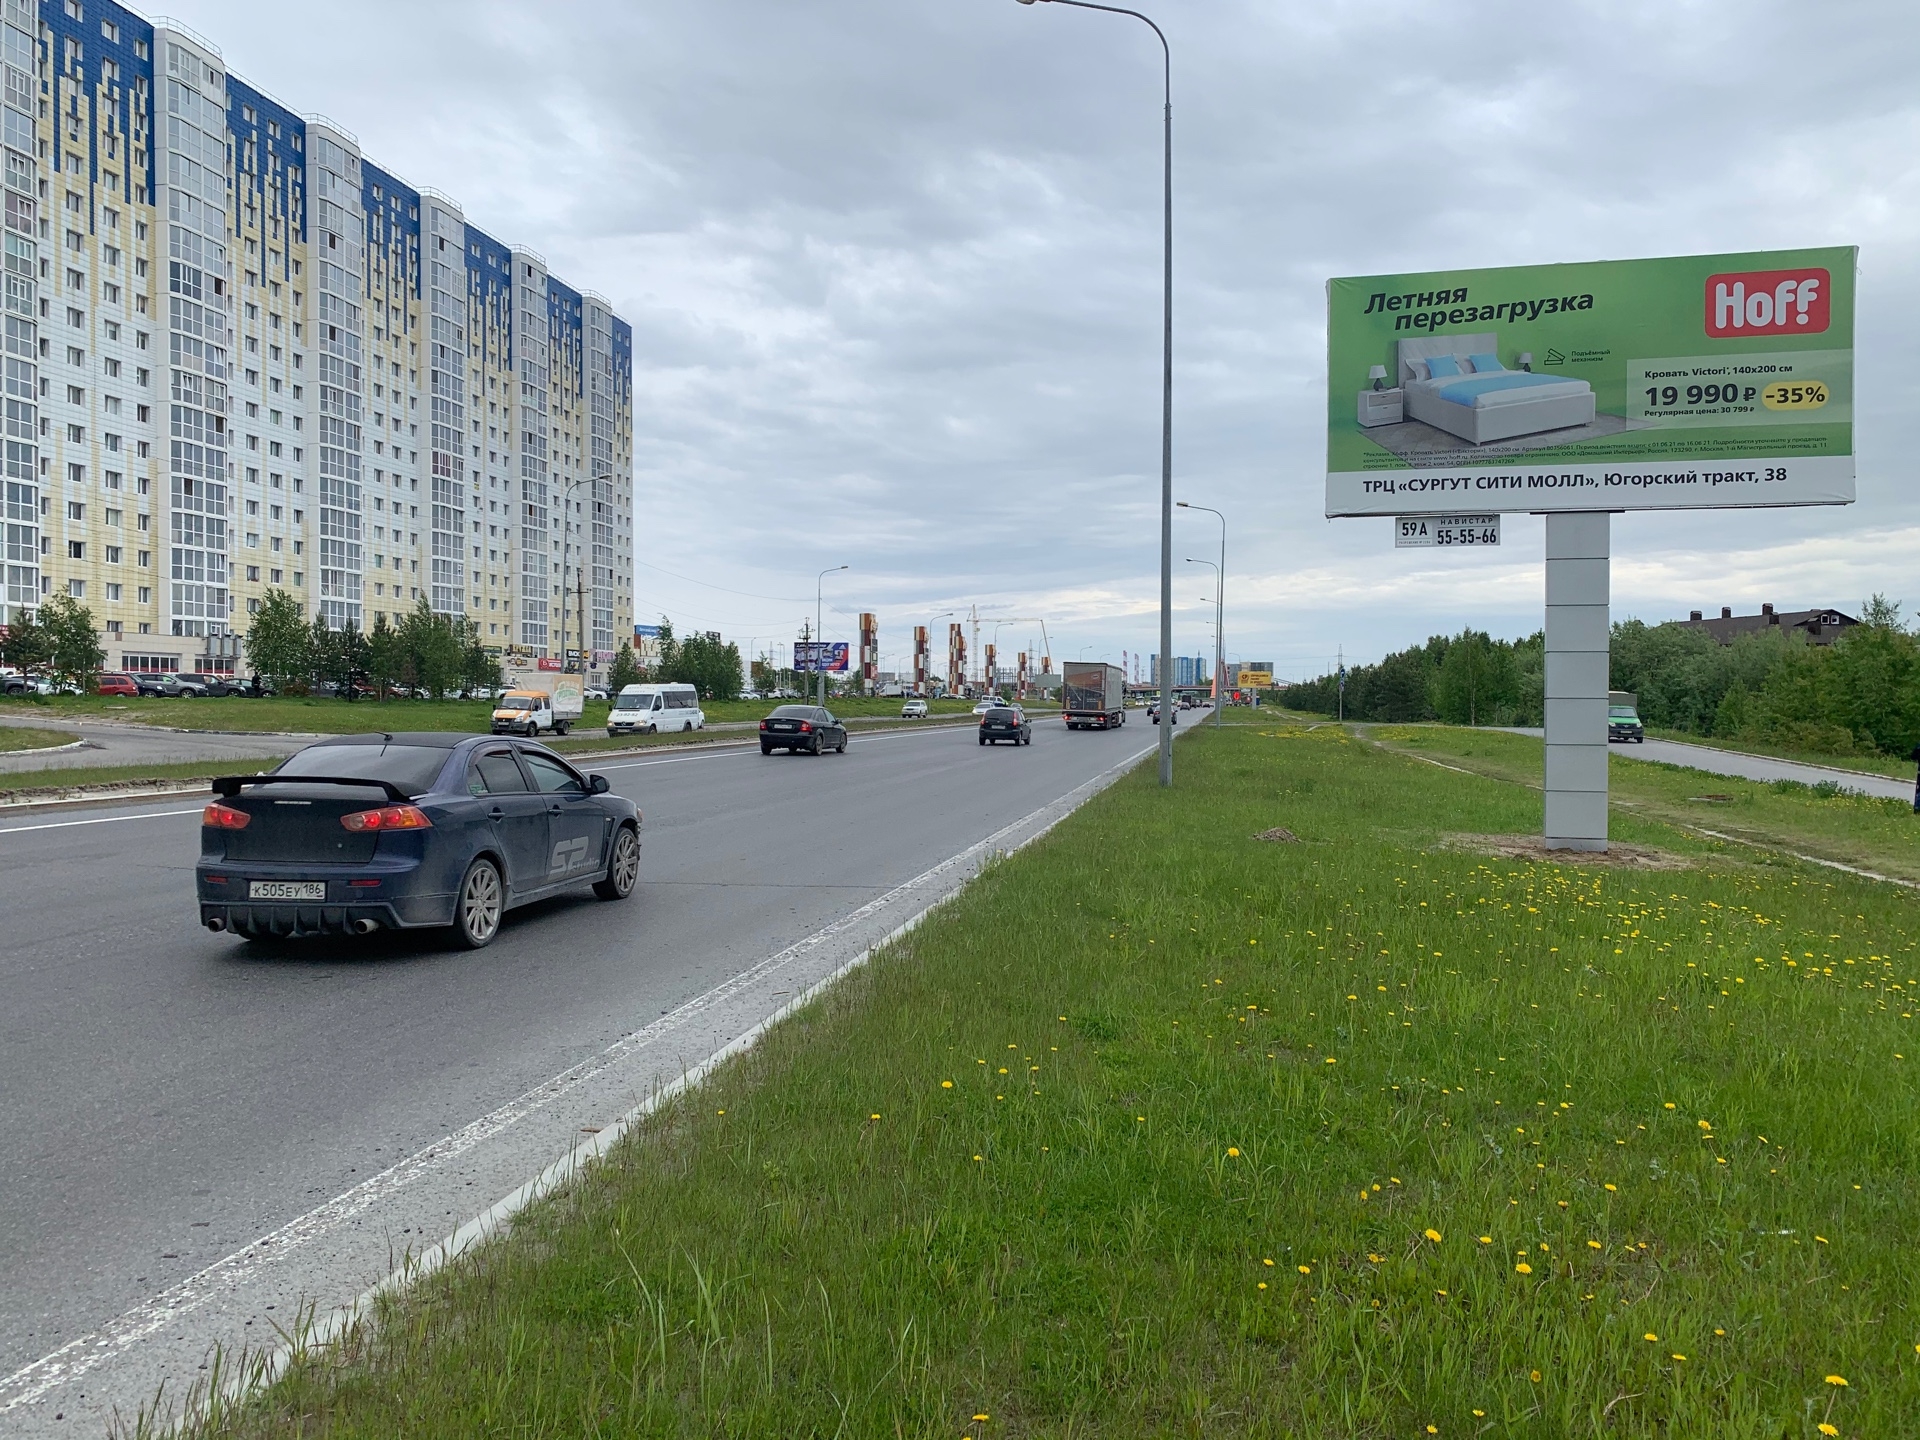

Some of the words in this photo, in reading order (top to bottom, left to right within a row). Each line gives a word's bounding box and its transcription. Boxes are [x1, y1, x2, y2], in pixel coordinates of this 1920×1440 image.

[1364, 287, 1468, 314] Летняя
[1395, 293, 1594, 332] перезагрузка
[1644, 369, 1689, 380] Кровать
[1778, 365, 1793, 373] см
[1645, 386, 1679, 406] 19
[1686, 383, 1739, 405] 990
[1765, 386, 1826, 404] -35%
[1644, 409, 1694, 418] Регулярная
[1696, 408, 1719, 416] цена:
[1733, 406, 1749, 414] 799
[1363, 480, 1395, 494] ТРЦ
[1398, 477, 1471, 492] «СУРГУТ
[1476, 475, 1522, 490] СИТИ
[1527, 474, 1599, 489] МОЛЛ»,
[1604, 470, 1698, 489] Югорский
[1702, 470, 1760, 486] тракт,
[1764, 467, 1788, 482] 38
[1440, 517, 1493, 526] НАВИСТАР
[1437, 528, 1497, 545] 55-55-66
